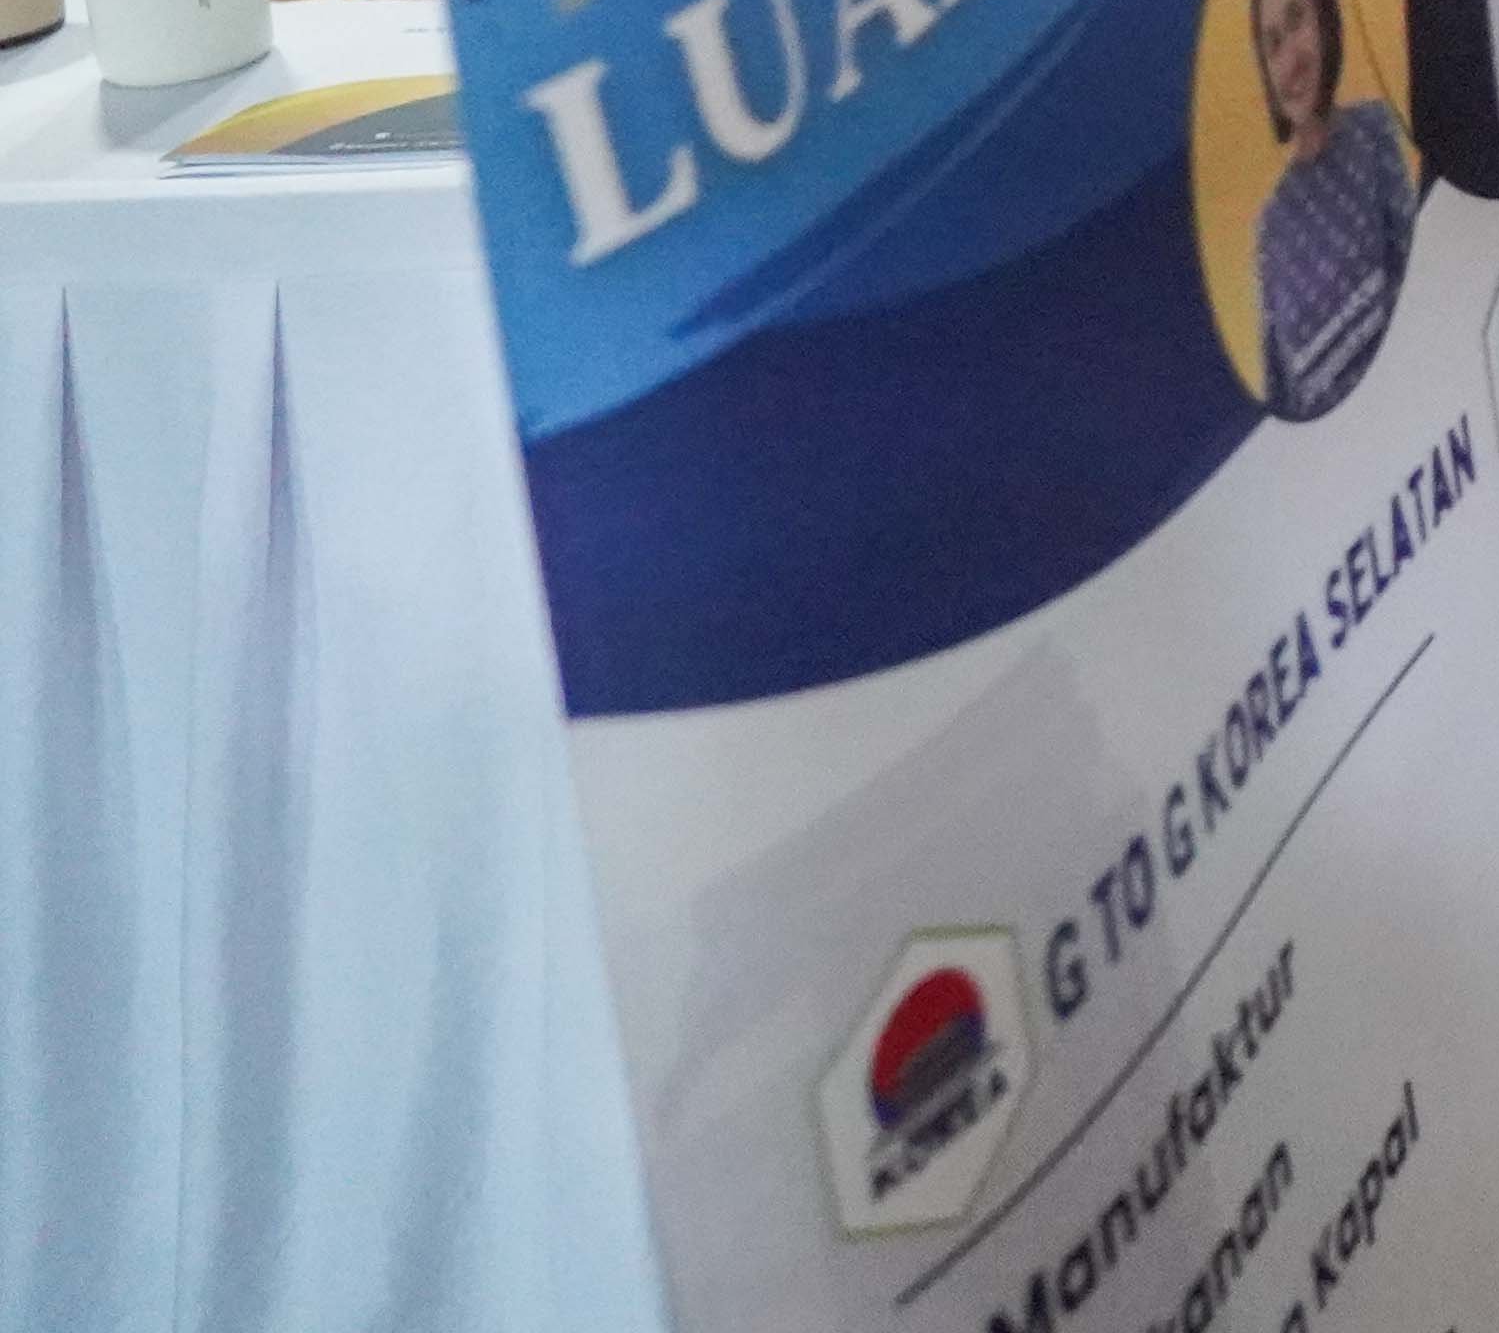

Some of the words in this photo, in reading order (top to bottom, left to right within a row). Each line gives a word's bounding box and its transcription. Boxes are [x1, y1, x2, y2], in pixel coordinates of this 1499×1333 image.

[1044, 916, 1087, 1021] G
[1091, 836, 1155, 964] TO
[1162, 781, 1196, 879] G
[1198, 611, 1322, 833] KOREA
[1326, 413, 1476, 650] SELATAN
[985, 936, 1294, 1333] Manufaktur
[1309, 1080, 1420, 1312] Kapal
